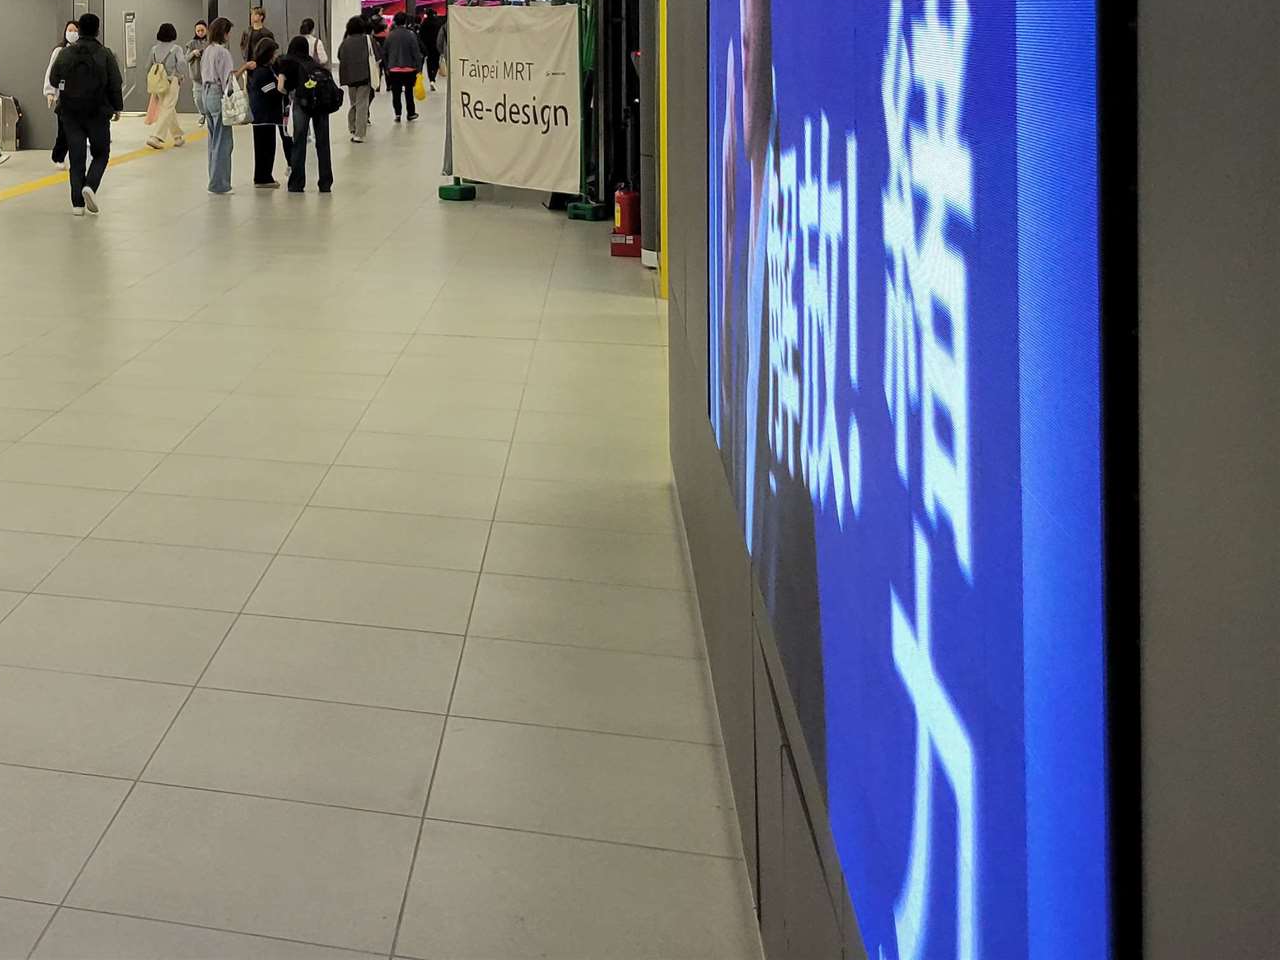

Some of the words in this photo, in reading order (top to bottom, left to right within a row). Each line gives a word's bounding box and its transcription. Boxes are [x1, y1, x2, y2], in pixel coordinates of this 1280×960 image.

[459, 58, 498, 83] Taipei
[503, 61, 534, 81] MRT
[460, 91, 569, 134] Re-design
